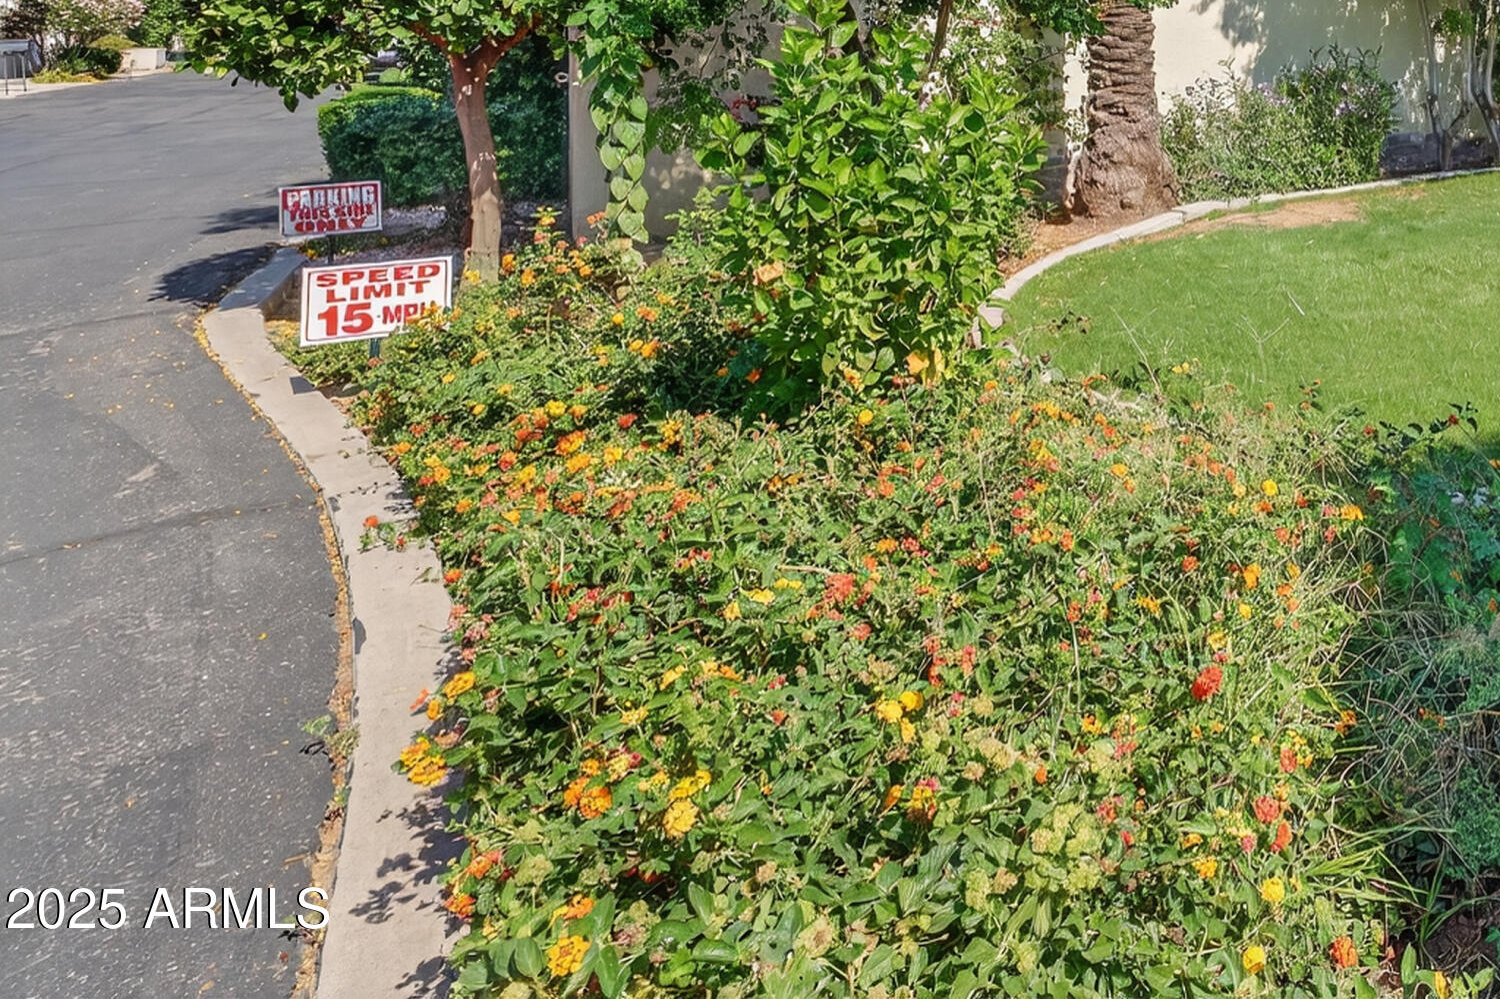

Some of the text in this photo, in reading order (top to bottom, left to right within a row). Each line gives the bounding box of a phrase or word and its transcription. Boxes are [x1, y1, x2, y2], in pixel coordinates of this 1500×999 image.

[286, 185, 375, 209] PARKING
[294, 216, 367, 234] ONLY
[316, 264, 441, 289] SPEED
[326, 280, 431, 303] LIMIT
[317, 302, 374, 337] 15
